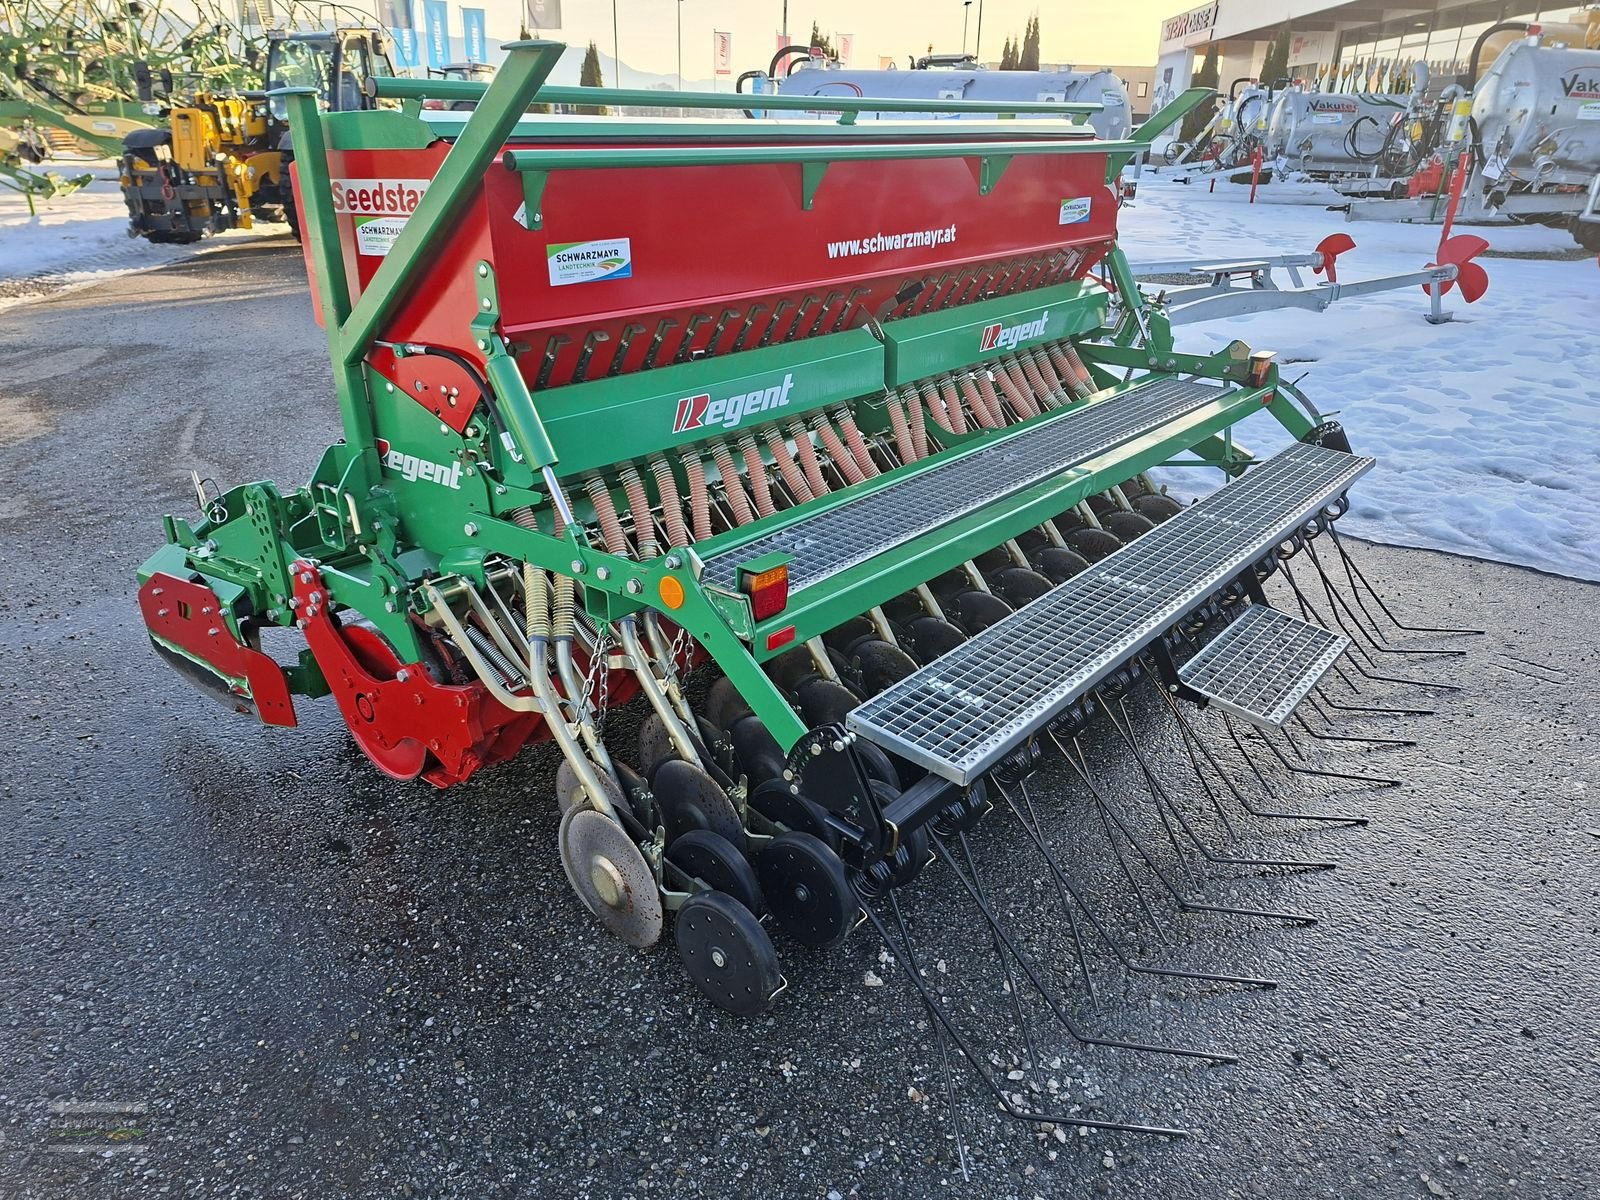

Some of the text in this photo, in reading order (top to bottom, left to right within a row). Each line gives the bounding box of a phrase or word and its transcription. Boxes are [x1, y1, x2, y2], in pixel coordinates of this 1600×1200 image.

[556, 248, 619, 263] SCHWARZMAYR
[827, 224, 956, 258] www.schwarzmayr.at
[558, 261, 596, 272] LANDTECHNIK
[980, 310, 1049, 352] Regent
[672, 373, 794, 434] Regent
